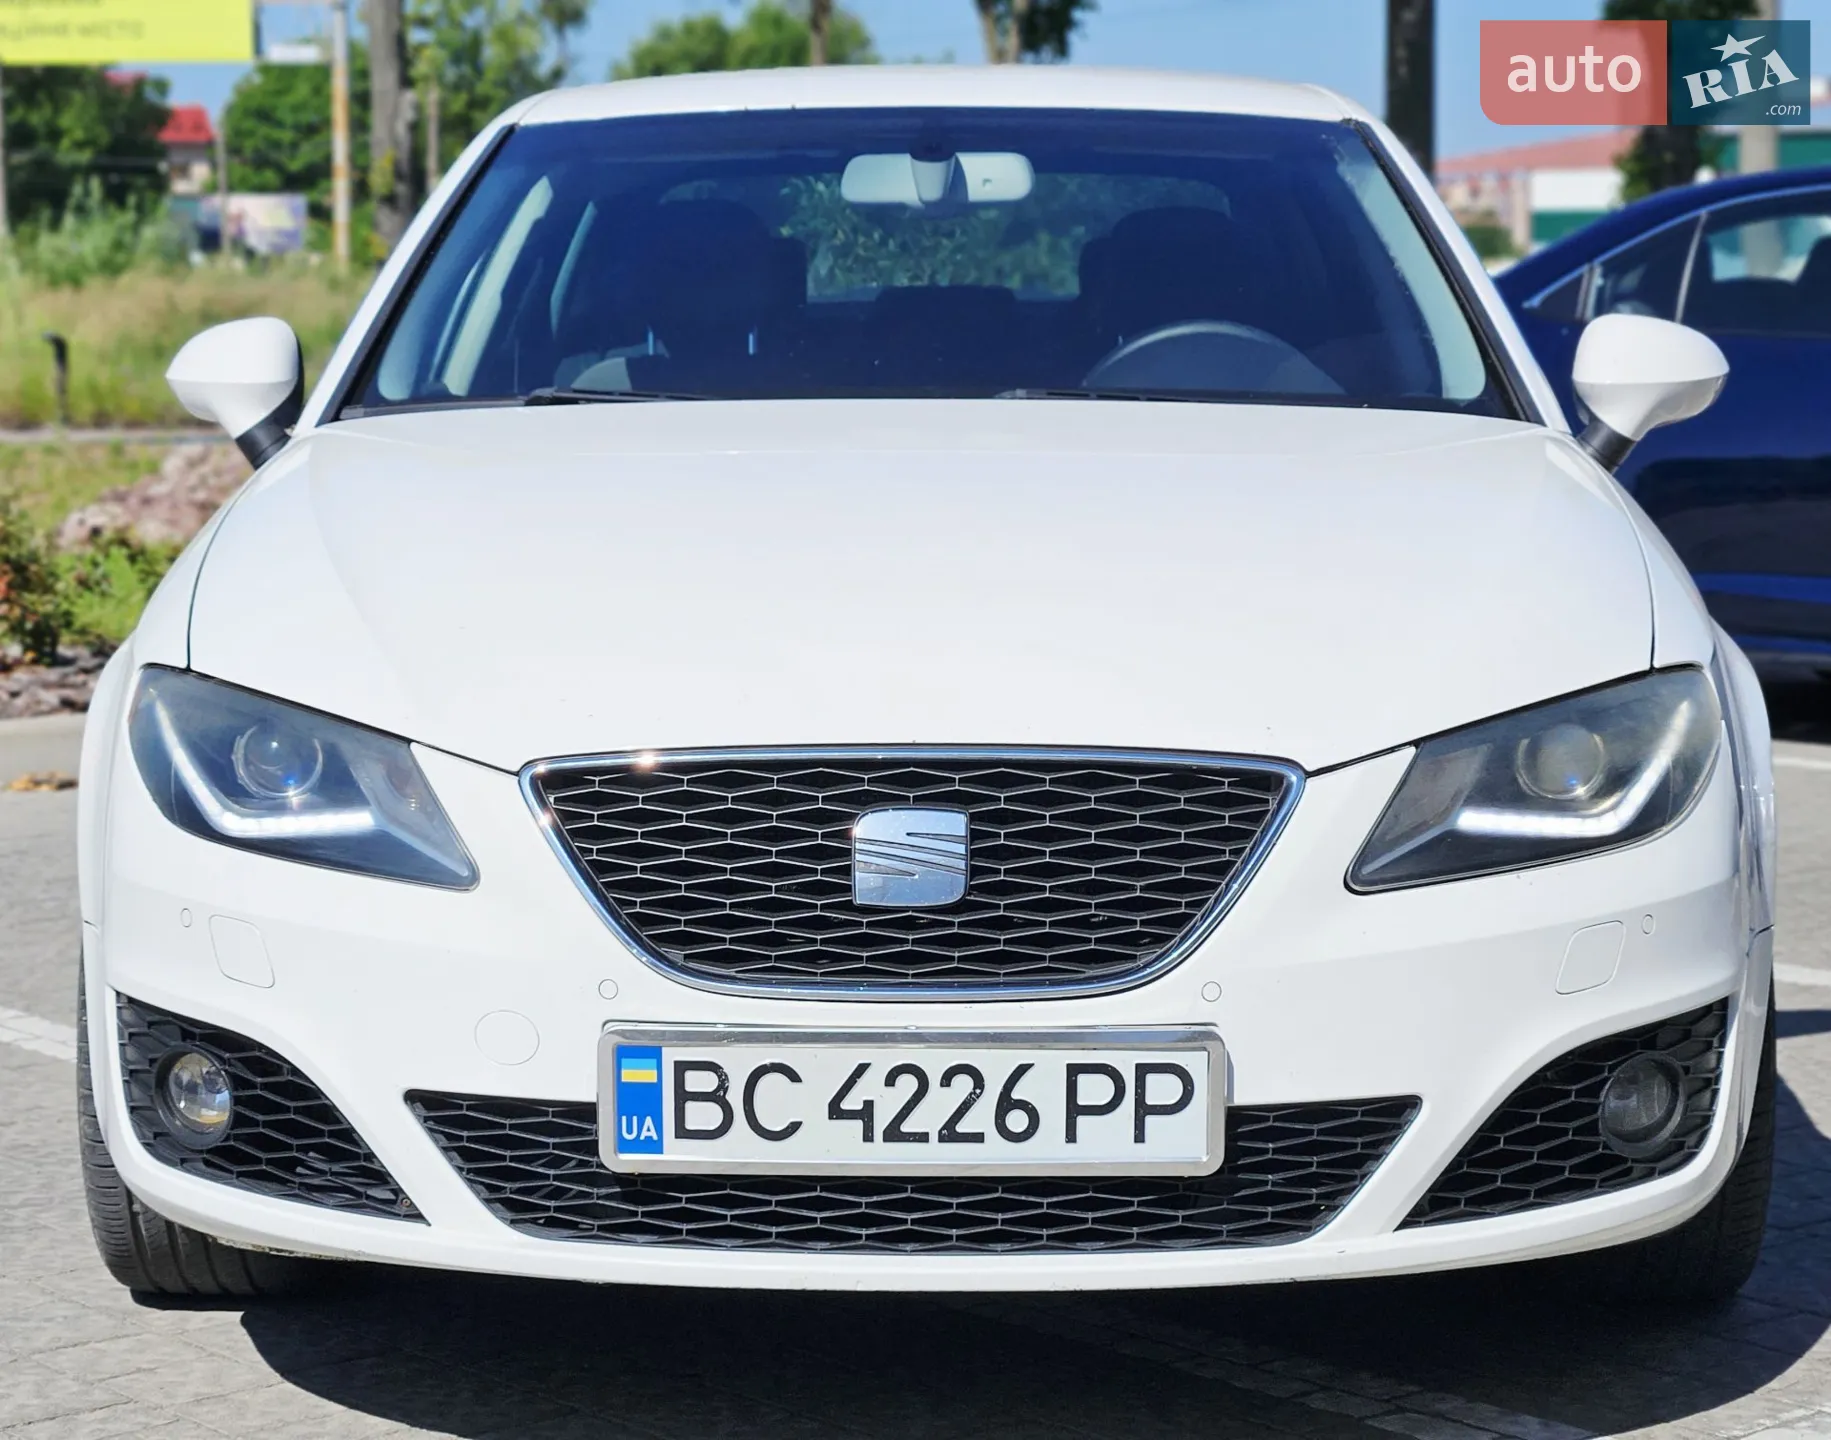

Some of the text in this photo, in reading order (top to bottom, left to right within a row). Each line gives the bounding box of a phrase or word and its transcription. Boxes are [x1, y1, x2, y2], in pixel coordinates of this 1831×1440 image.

[621, 1115, 658, 1141] UA
[673, 1060, 1195, 1144] BC 4226 PP
